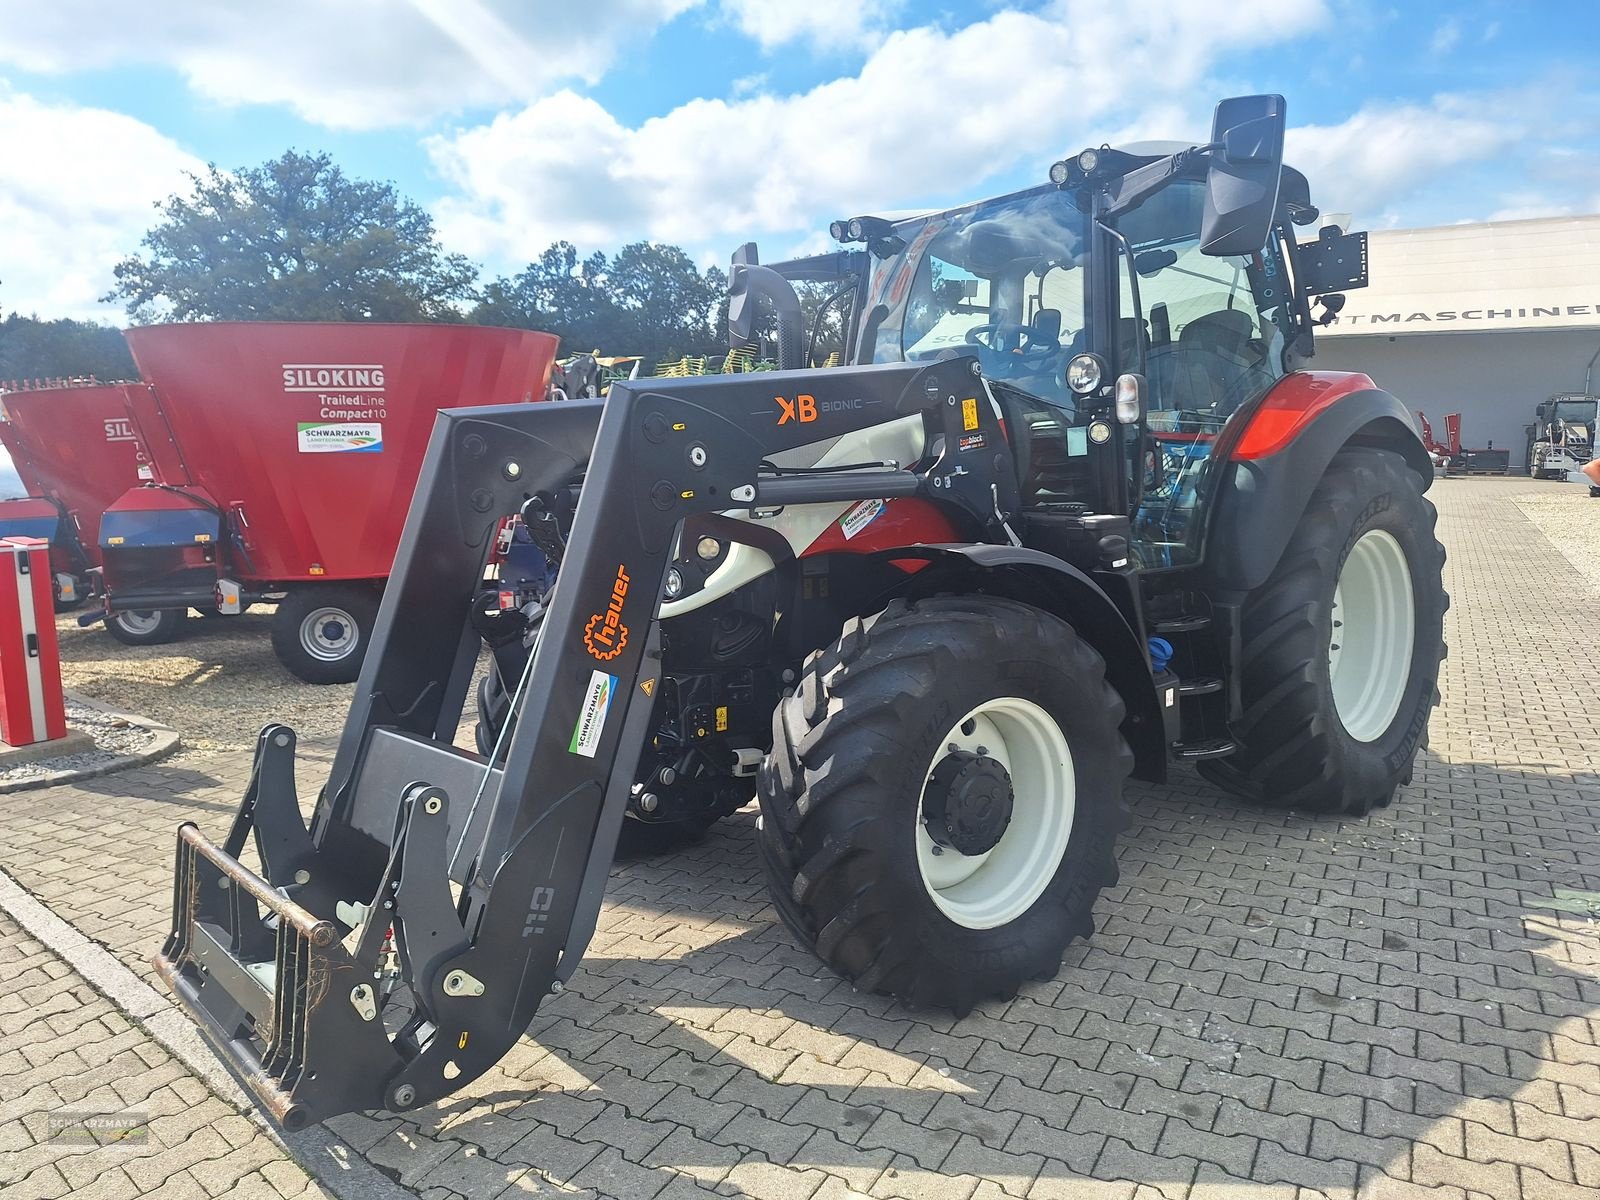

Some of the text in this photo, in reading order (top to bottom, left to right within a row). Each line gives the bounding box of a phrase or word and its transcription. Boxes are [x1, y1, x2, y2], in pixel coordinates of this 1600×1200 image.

[283, 370, 384, 386] SILOKING
[318, 394, 384, 406] TrailedLine
[821, 399, 862, 412] BIONIC
[320, 408, 386, 420] Compact10
[845, 500, 877, 527] SCHWARZMAYR
[594, 564, 630, 646] hauer
[578, 683, 602, 747] SCHWARZMAYR
[522, 886, 555, 938] 110
